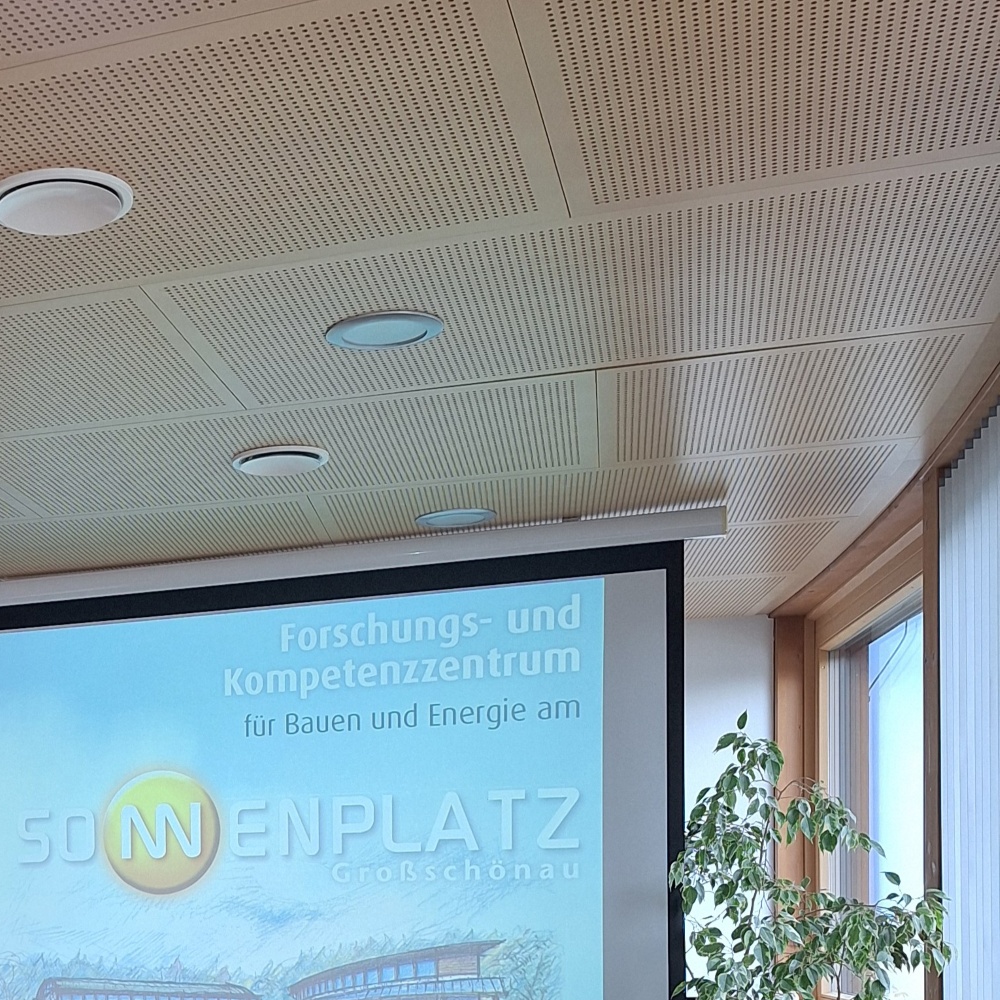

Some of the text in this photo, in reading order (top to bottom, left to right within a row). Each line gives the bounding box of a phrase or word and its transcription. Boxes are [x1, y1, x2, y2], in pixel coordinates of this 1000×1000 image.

[280, 593, 581, 652] Forschungs- und
[223, 646, 581, 699] Kompetenzzentrum
[244, 698, 581, 737] für Bauen und Energie am
[331, 860, 580, 885] Großschönau
